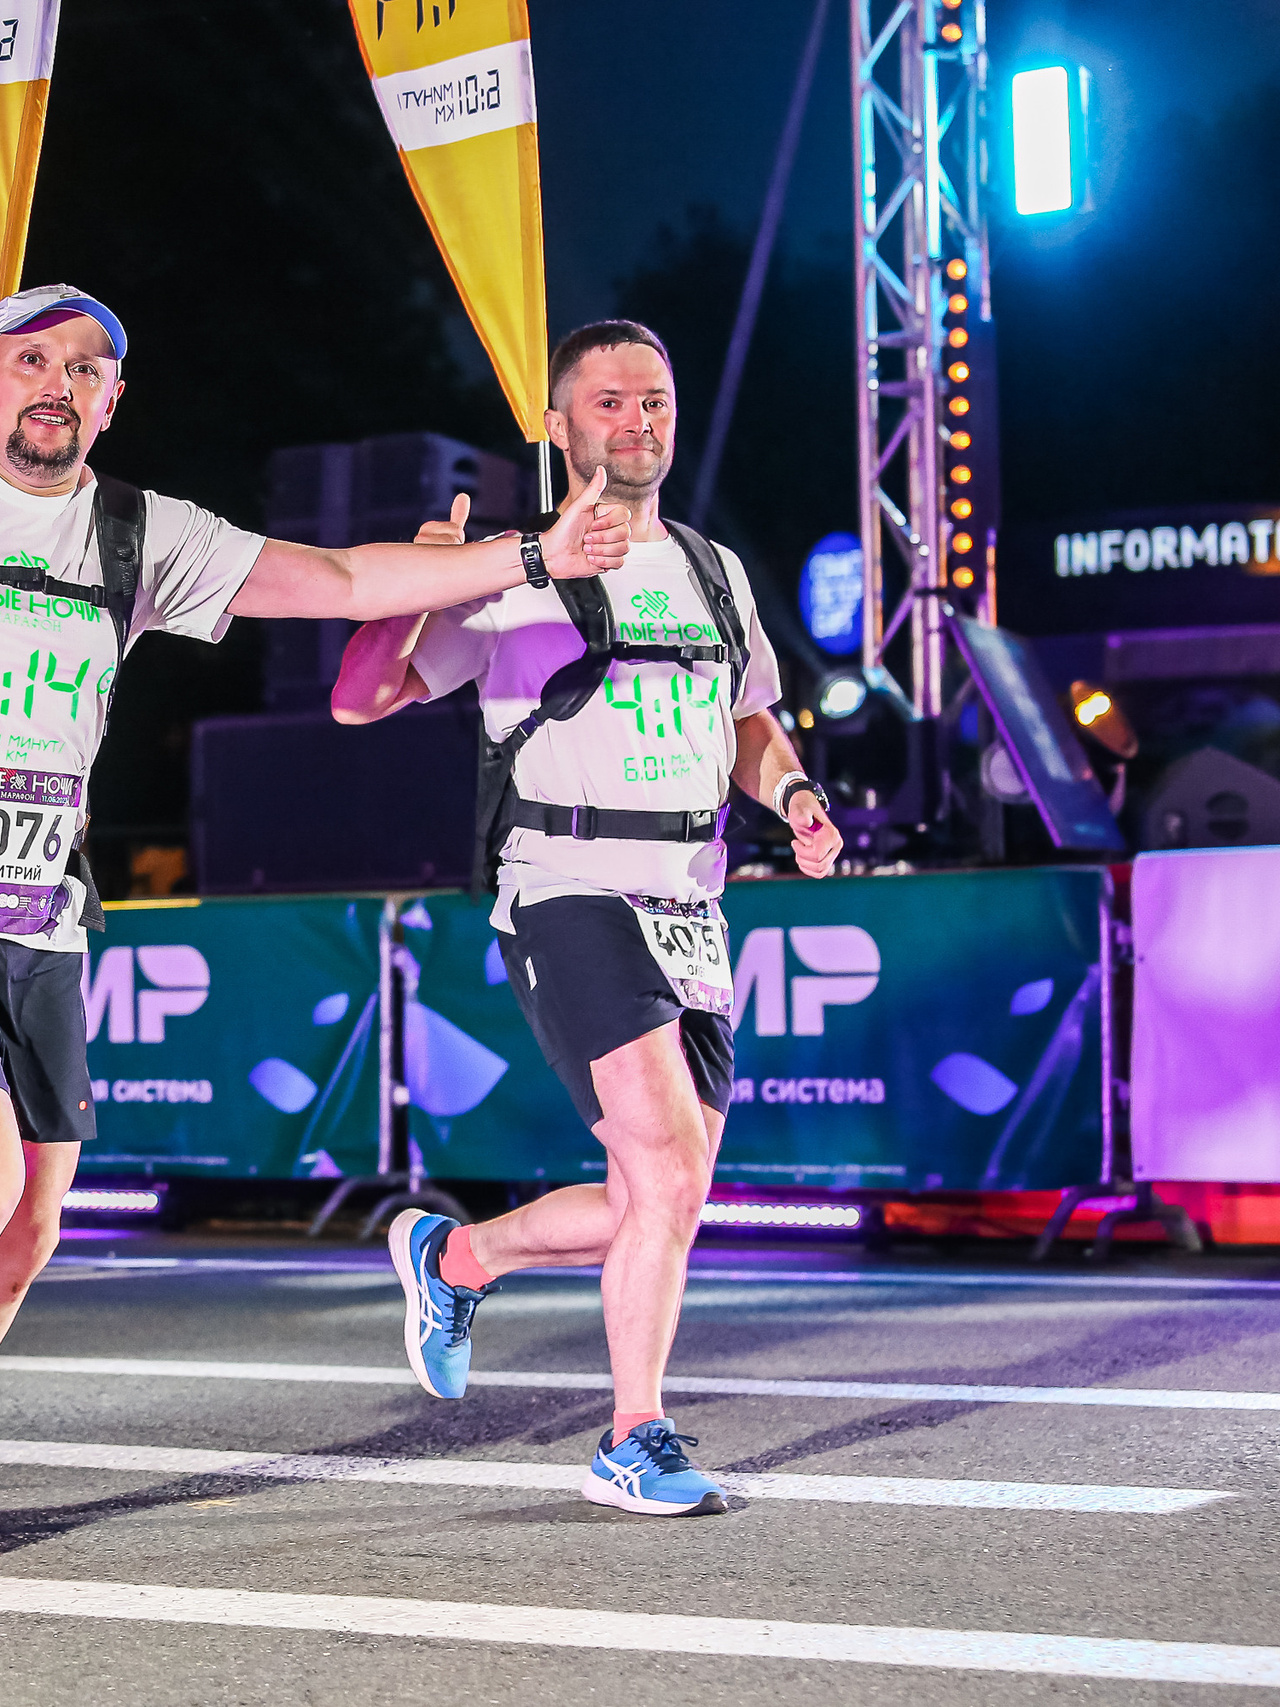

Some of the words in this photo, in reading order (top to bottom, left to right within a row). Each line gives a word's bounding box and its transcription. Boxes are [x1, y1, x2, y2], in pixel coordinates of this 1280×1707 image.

[29, 594, 101, 624] НОЧИ
[620, 622, 657, 642] ЛЫЕ
[603, 673, 720, 739] 4:14
[5, 750, 29, 764] КМ
[0, 791, 35, 802] МАРАФОН
[32, 774, 76, 796] НОЧИ
[652, 920, 720, 966] 4075
[761, 1077, 886, 1104] система
